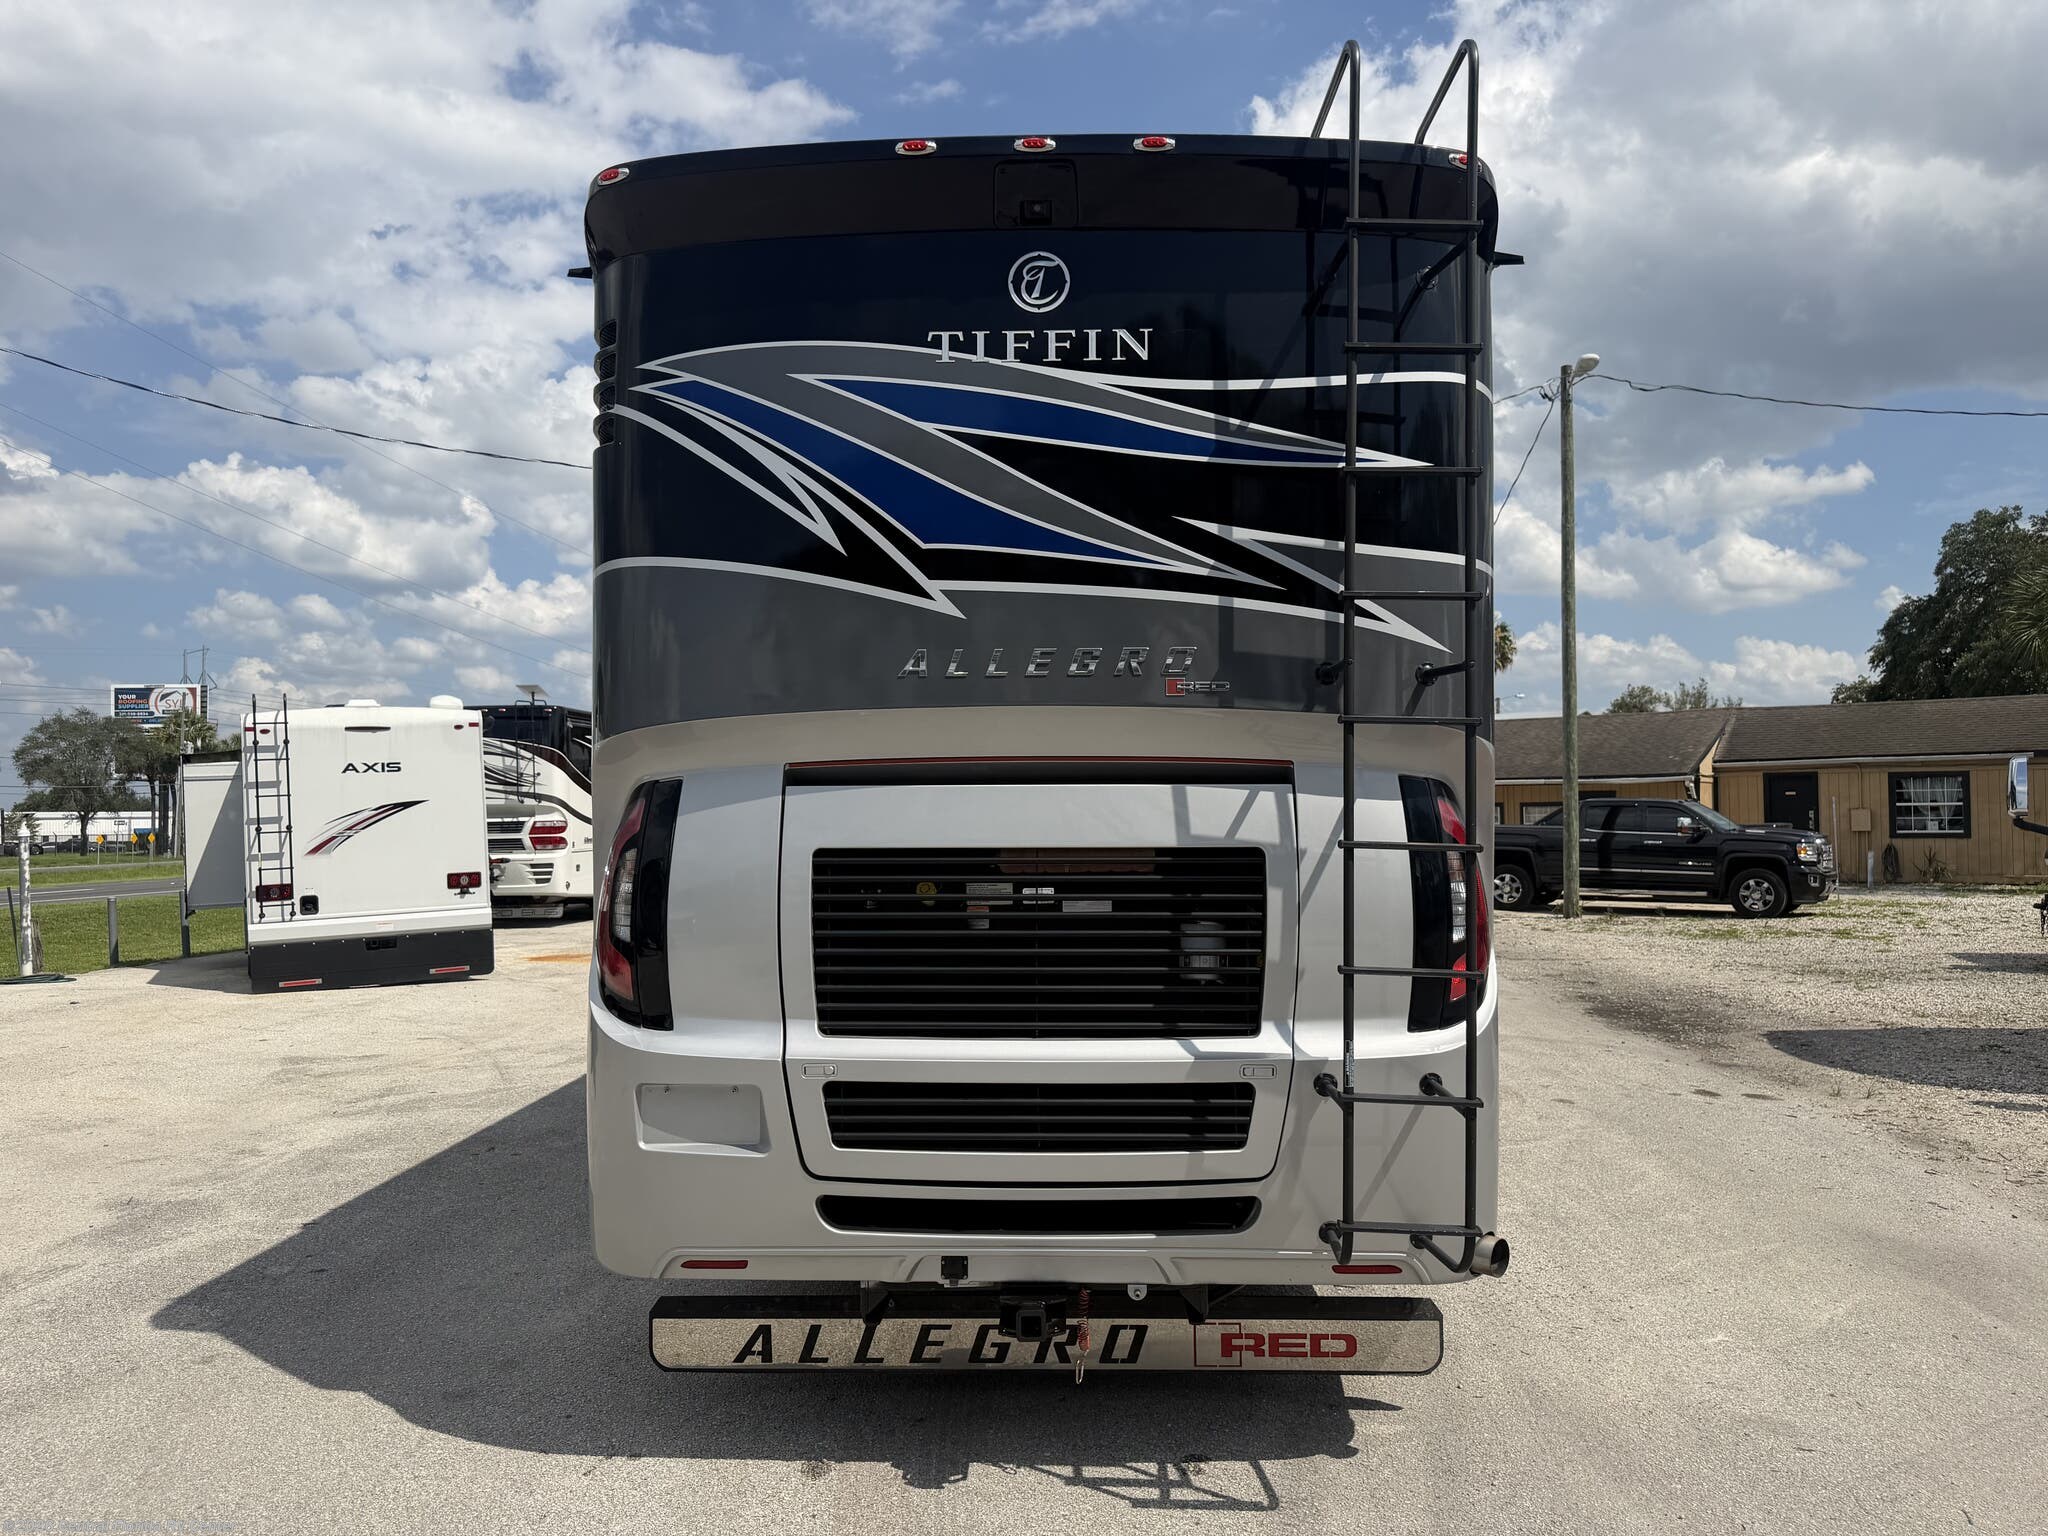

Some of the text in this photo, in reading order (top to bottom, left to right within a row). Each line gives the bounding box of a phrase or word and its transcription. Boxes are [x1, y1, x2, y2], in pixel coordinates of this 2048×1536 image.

[927, 328, 1154, 363] TIFFIN
[897, 646, 1198, 677] ALLEGRO
[1175, 680, 1230, 692] RED
[341, 762, 402, 774] AXIS
[732, 1323, 1358, 1365] ALLEGRO RED
